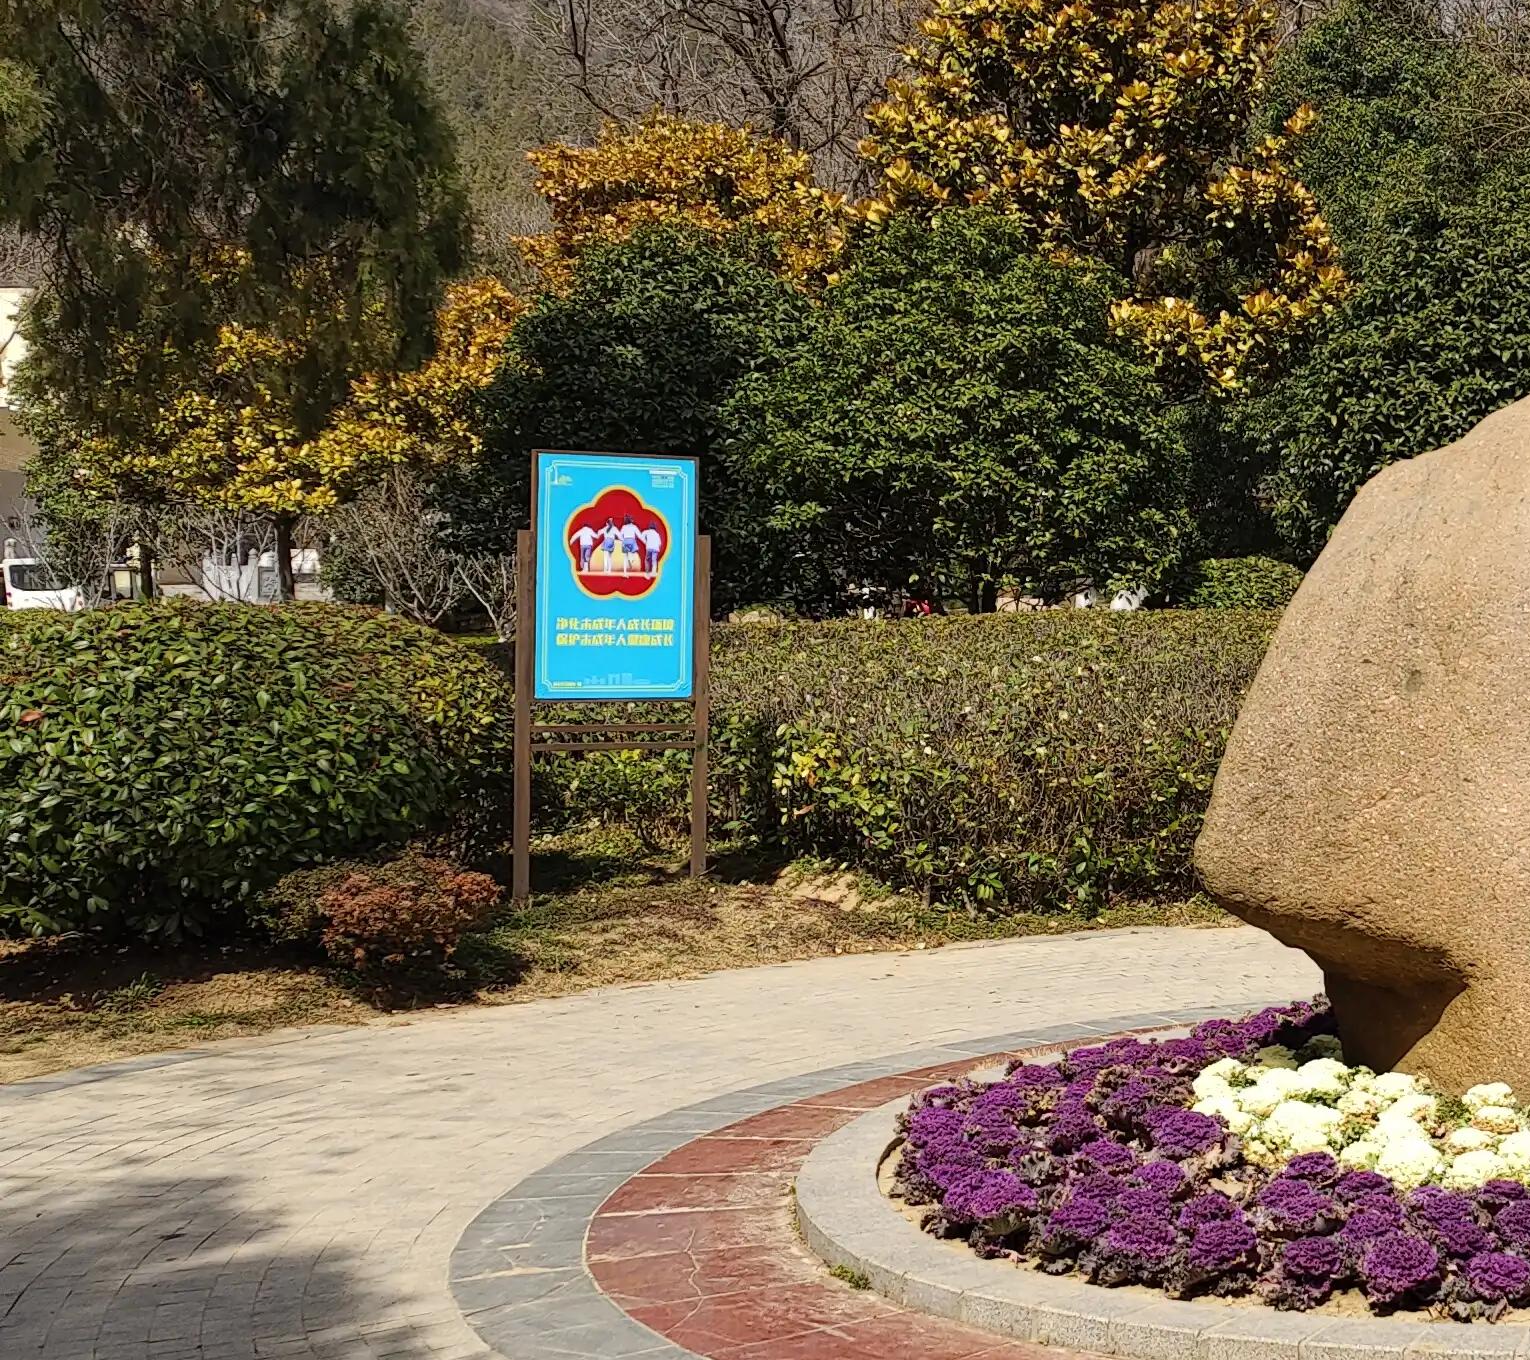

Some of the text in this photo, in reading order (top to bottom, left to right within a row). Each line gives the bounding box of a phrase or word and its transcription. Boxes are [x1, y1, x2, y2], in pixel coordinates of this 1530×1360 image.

[556, 632, 674, 647] 保护未成年人成长
